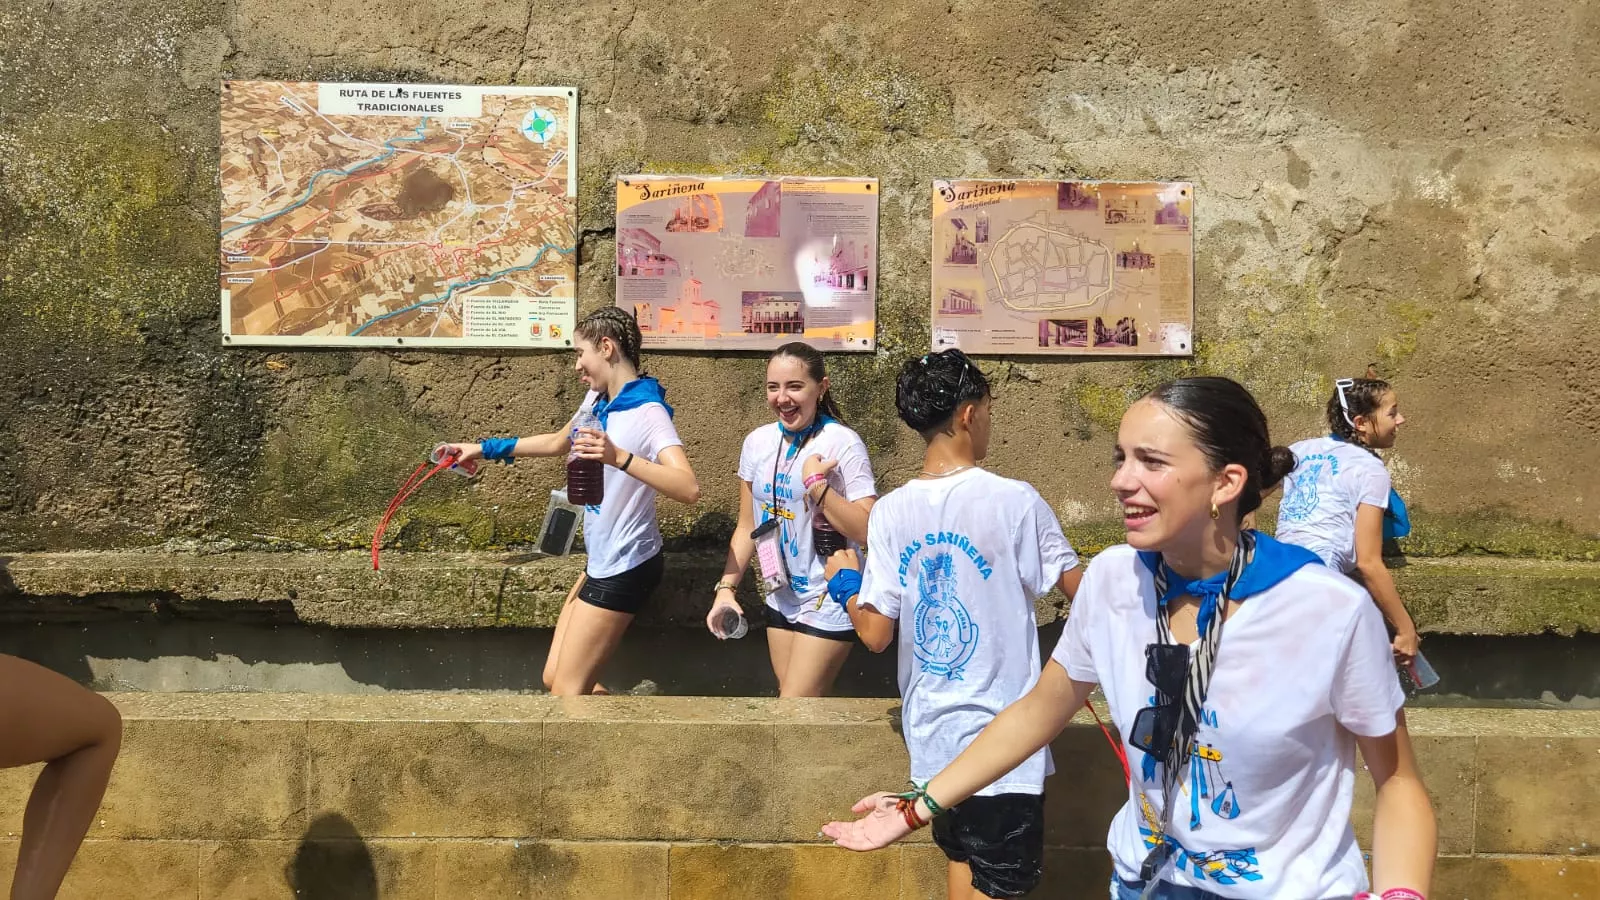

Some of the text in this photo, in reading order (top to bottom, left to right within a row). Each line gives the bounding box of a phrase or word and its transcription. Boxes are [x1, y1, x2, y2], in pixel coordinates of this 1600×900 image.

[339, 89, 462, 100] RUTA DE LAS FUENTES
[357, 103, 444, 113] TRADICIONALES
[636, 181, 705, 201] Sariñena
[942, 183, 1016, 203] Sariñena
[898, 531, 993, 588] PEÑAS SARIÑENA
